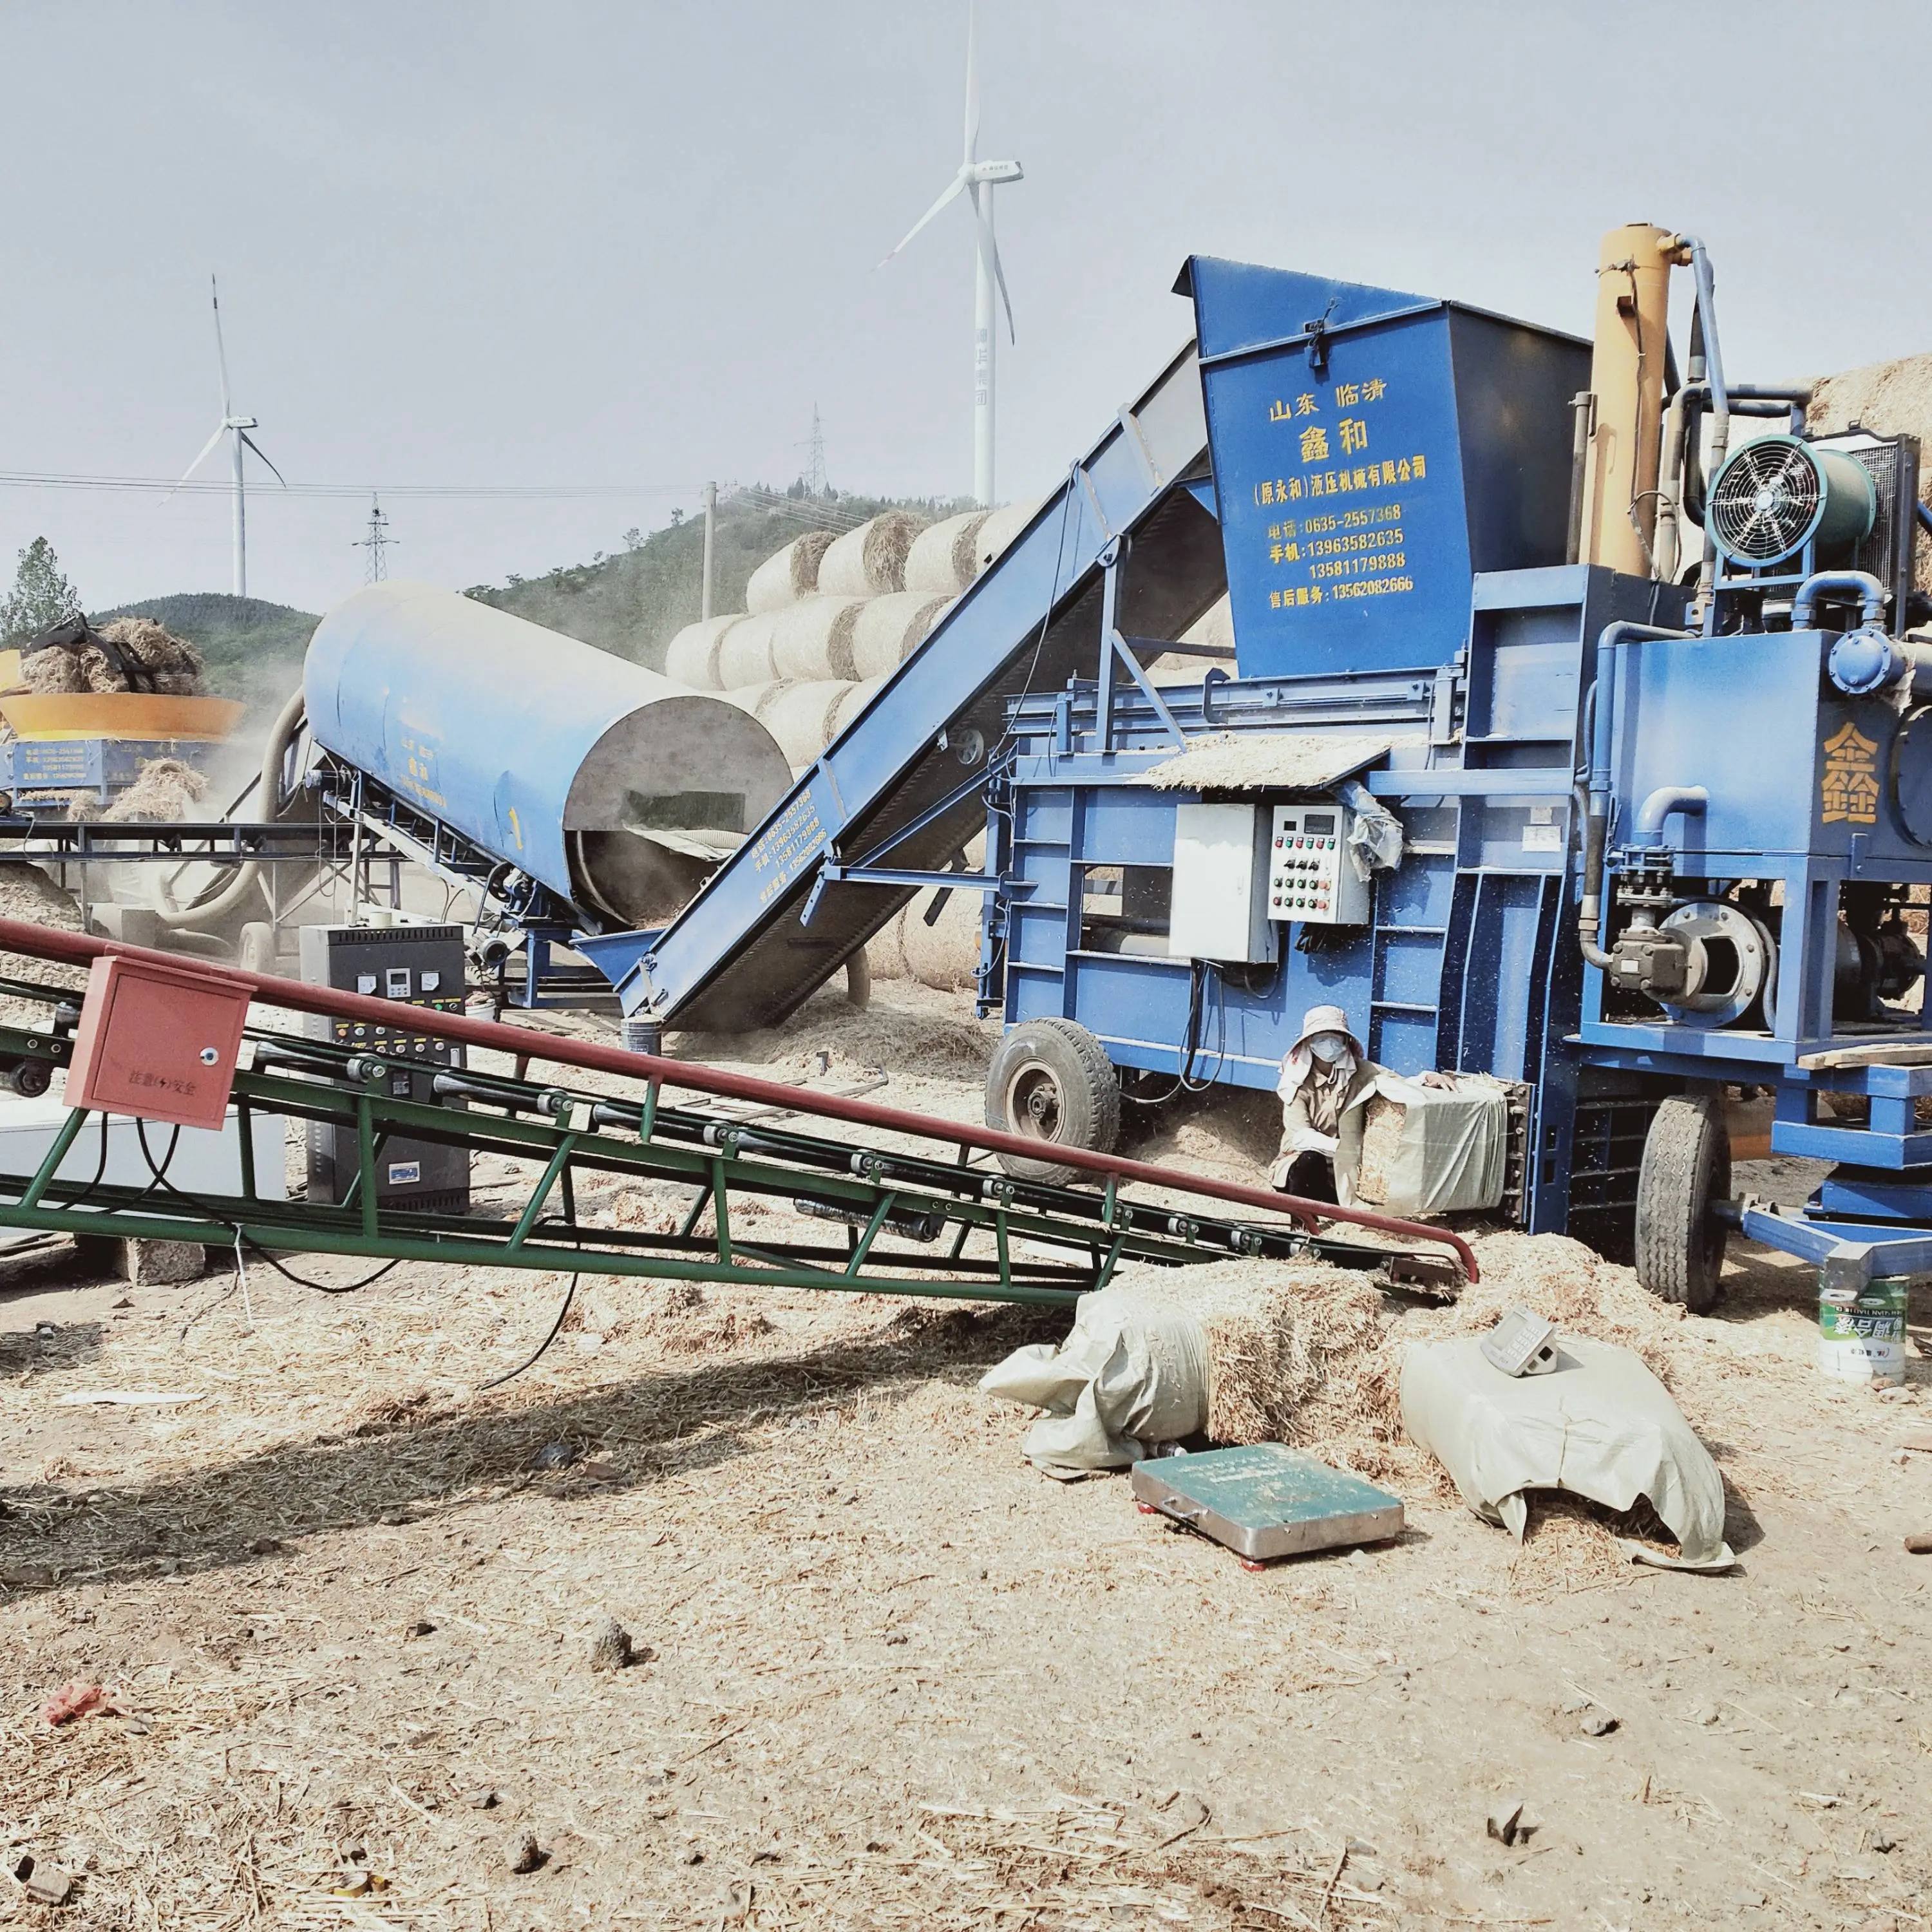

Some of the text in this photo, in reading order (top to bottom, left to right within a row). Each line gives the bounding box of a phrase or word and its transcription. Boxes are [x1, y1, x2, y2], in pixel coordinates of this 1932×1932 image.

[1269, 378, 1387, 422] 山东 临清
[1299, 418, 1368, 463] 鑫和
[1309, 552, 1406, 579] 13581179888
[1821, 721, 1880, 824] 鑫
